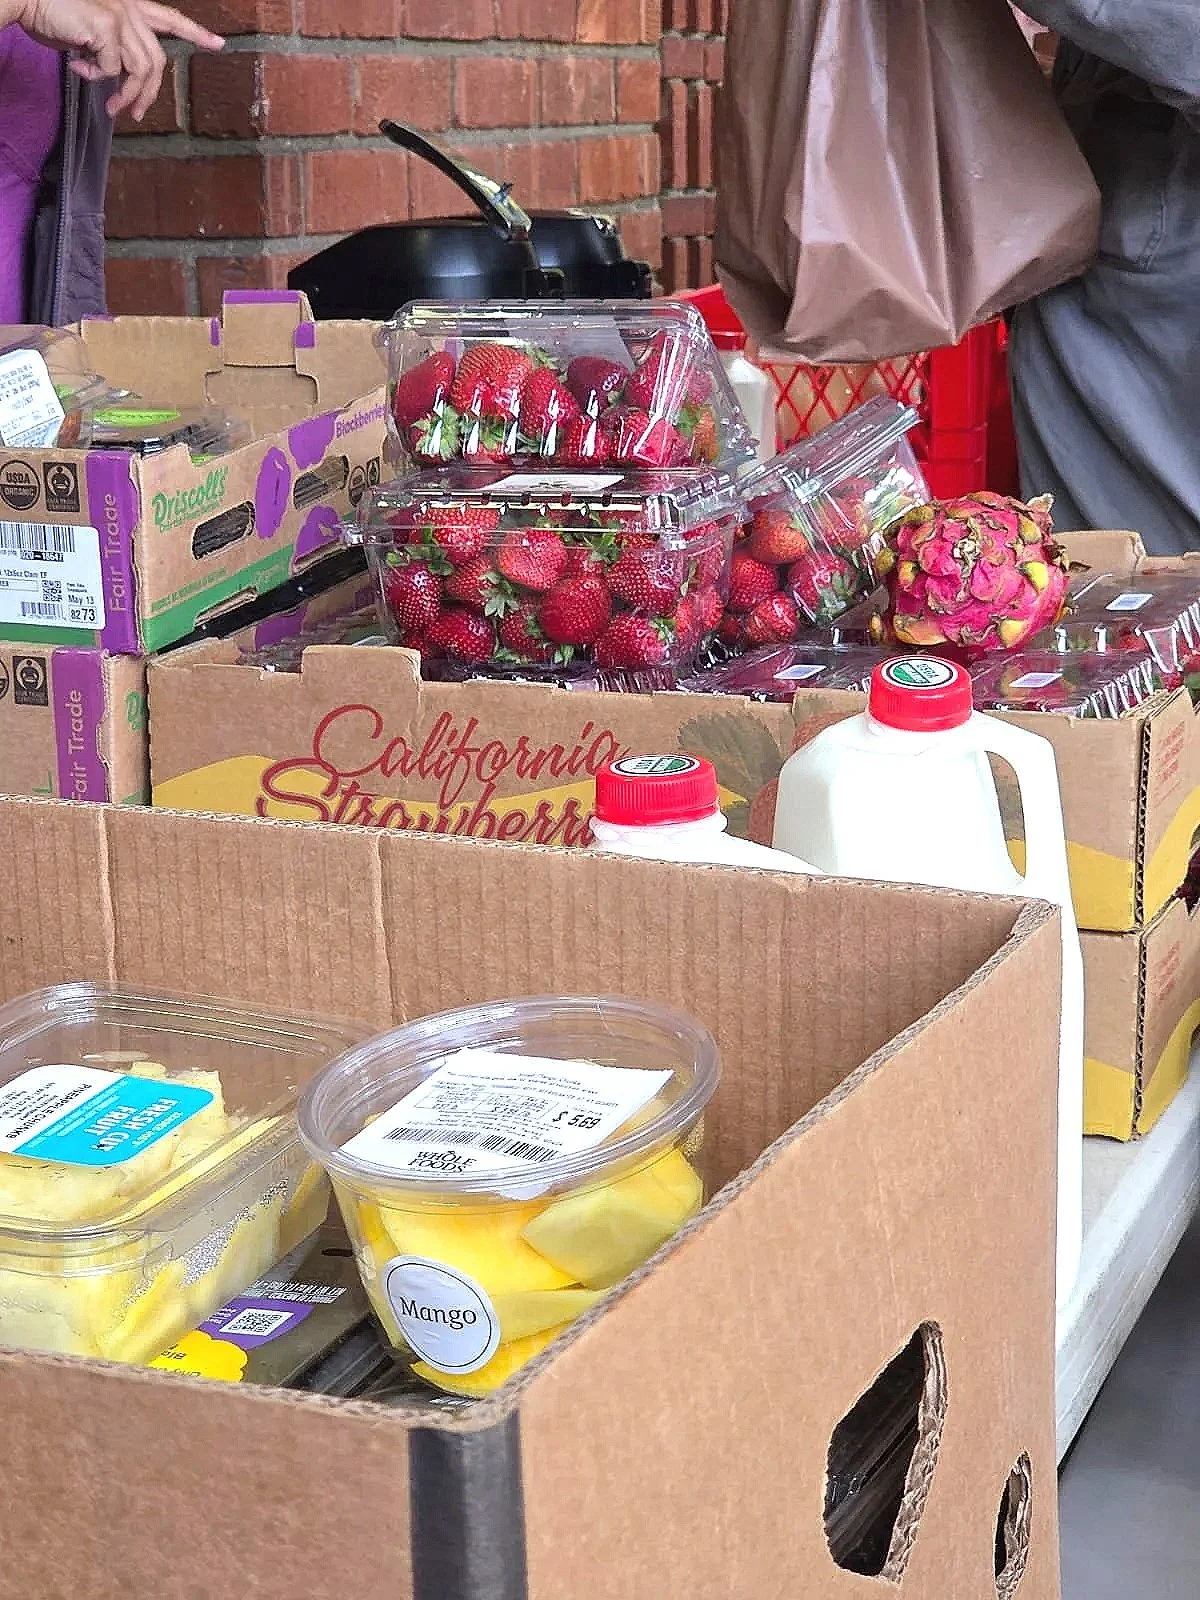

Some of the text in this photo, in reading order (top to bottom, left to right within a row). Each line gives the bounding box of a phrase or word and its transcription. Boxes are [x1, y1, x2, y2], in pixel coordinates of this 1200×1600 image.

[6, 472, 30, 484] USDA
[104, 494, 128, 612] Fair Trade
[64, 689, 85, 755] Trade
[312, 704, 626, 810] California
[83, 1105, 137, 1136] FRUIT
[120, 1097, 179, 1130] FRESH
[567, 1114, 601, 1129] 5.69
[407, 1158, 463, 1173] FOODS
[417, 1150, 477, 1167] WHOLE
[399, 1296, 477, 1329] Mango
